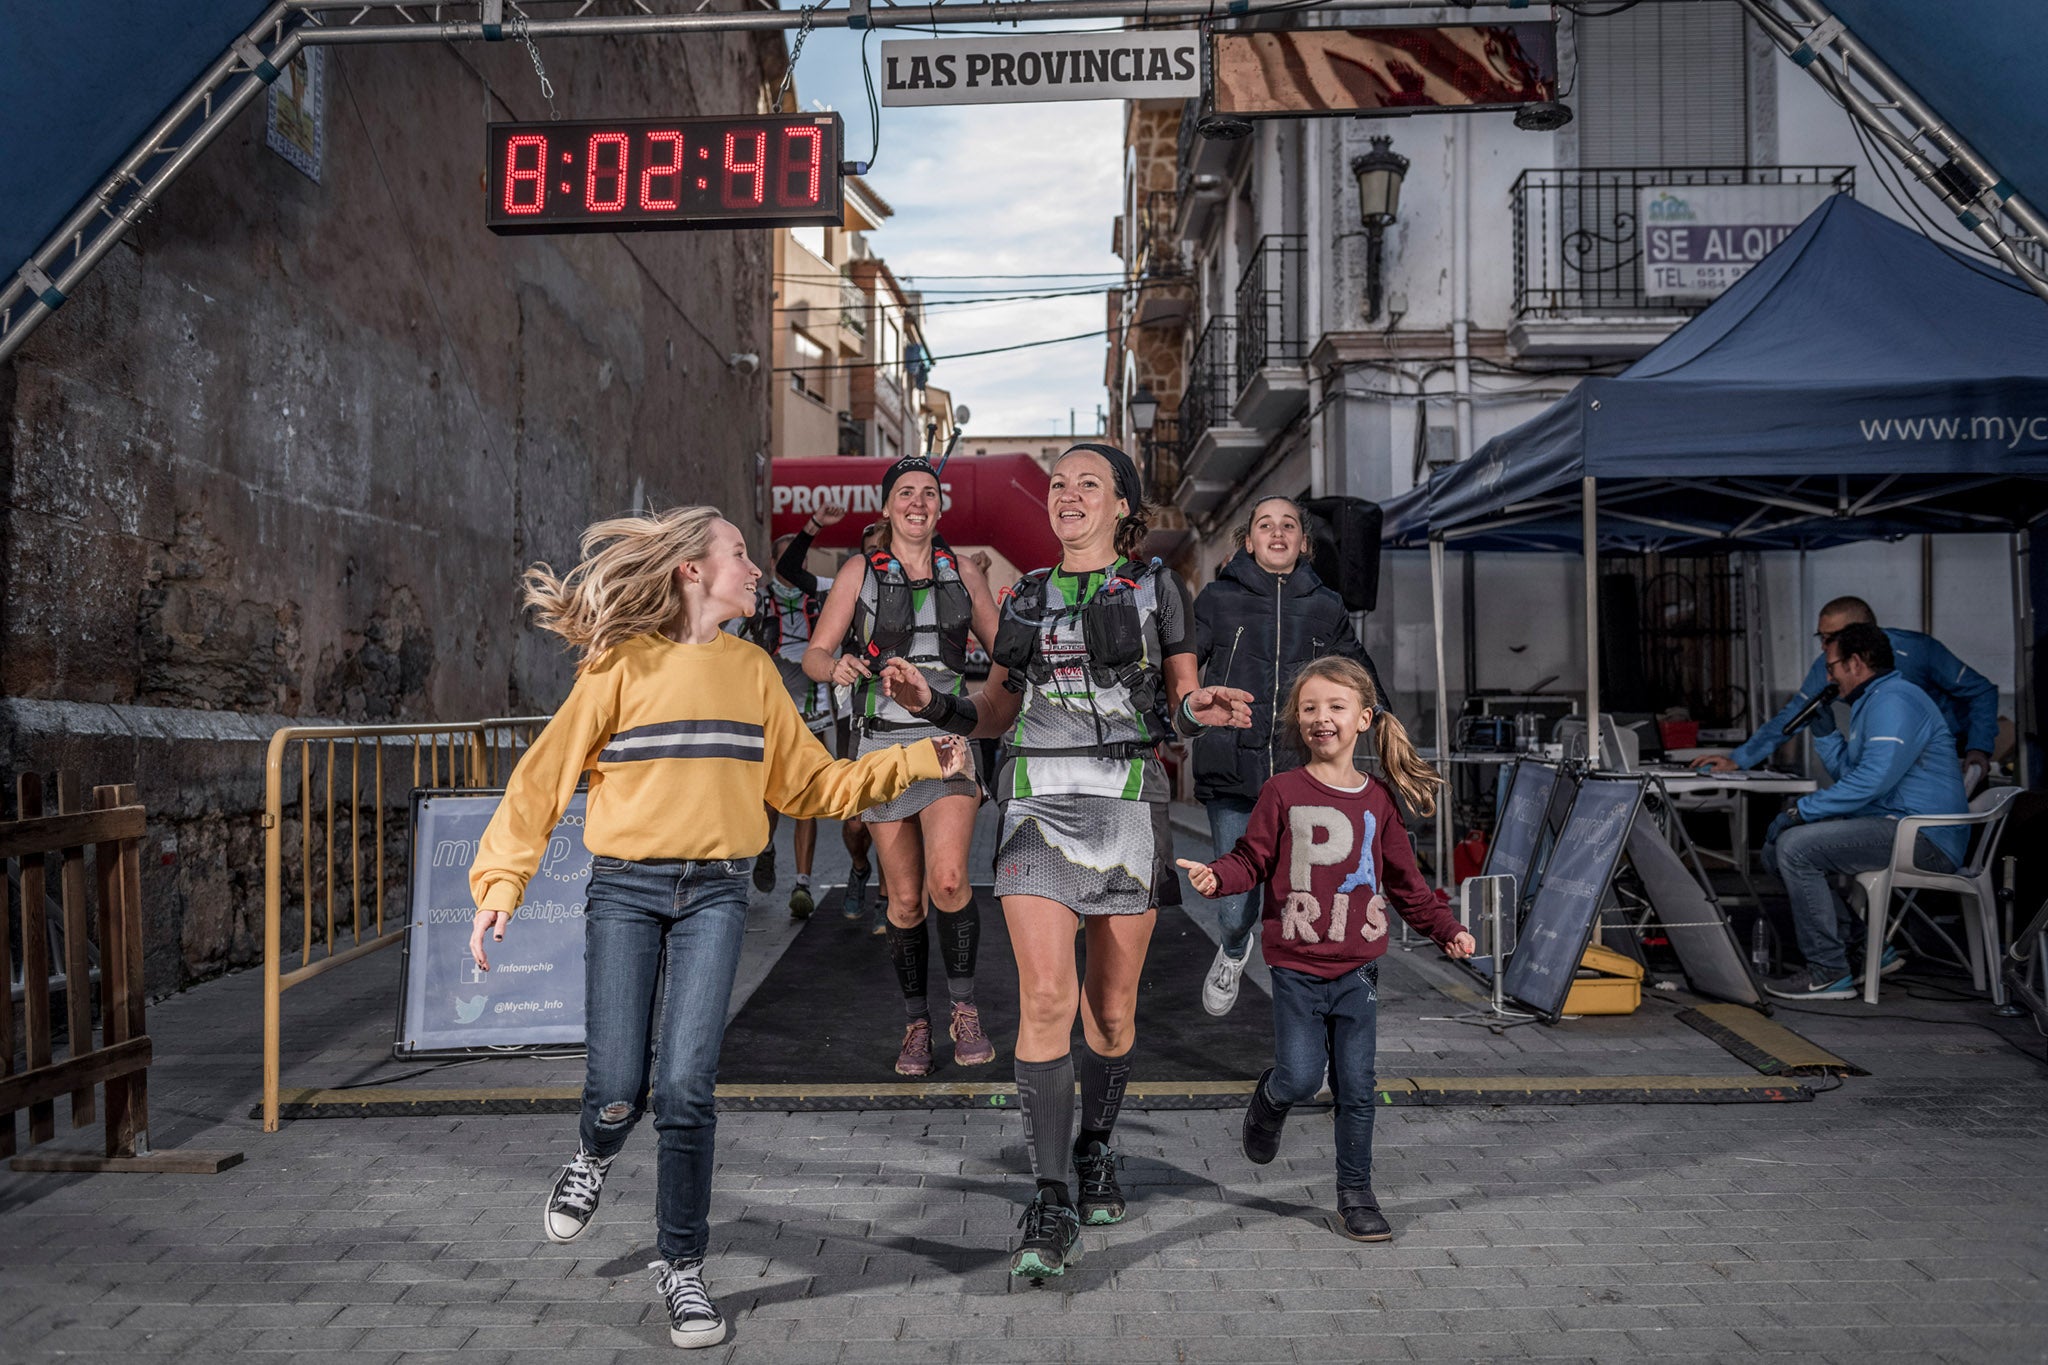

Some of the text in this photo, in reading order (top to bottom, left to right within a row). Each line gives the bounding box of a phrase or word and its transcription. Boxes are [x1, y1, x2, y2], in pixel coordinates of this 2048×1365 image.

[886, 46, 1196, 90] LAS PROVINCIAS
[504, 126, 822, 214] 8:02:47
[1652, 228, 1690, 261] SE
[772, 484, 952, 514] PROVINS
[497, 962, 554, 973] /infomychip
[494, 999, 564, 1014] @Mychip_Info
